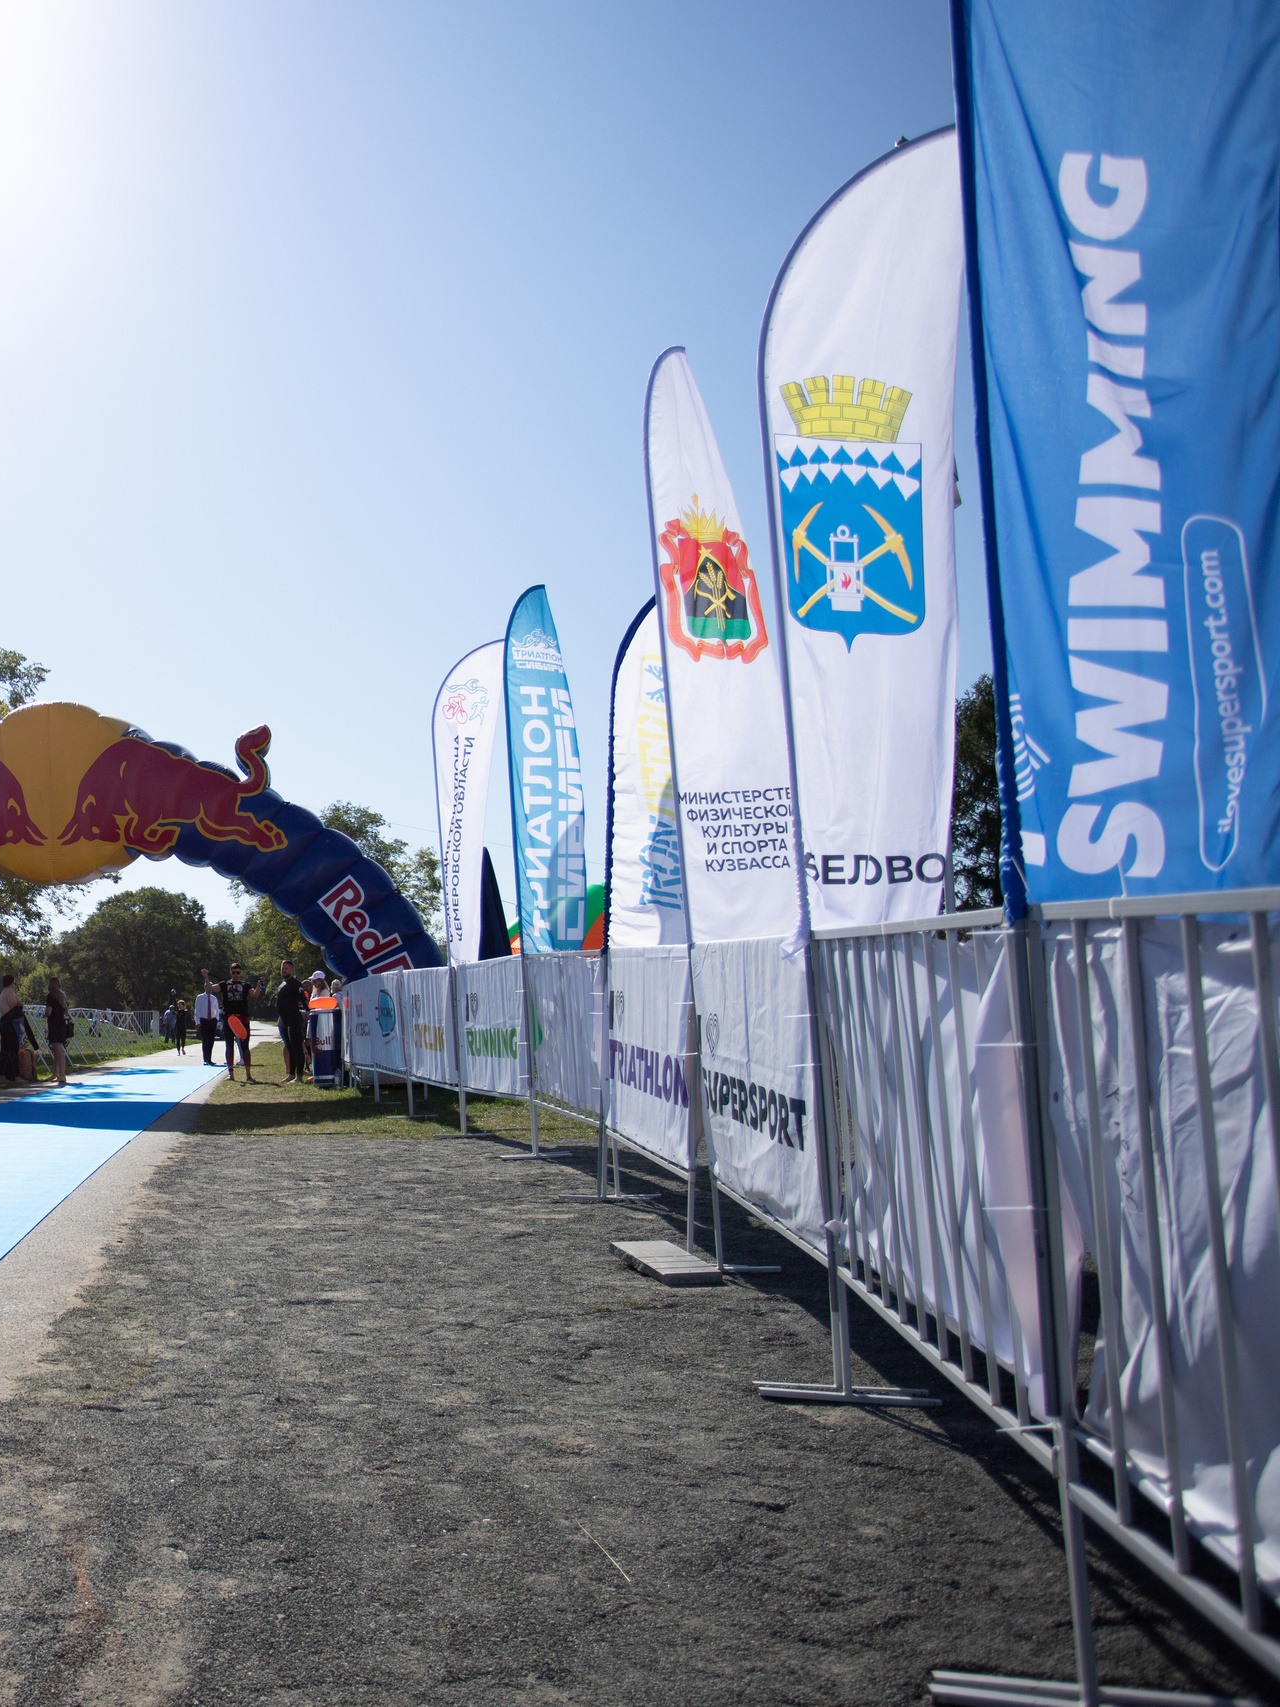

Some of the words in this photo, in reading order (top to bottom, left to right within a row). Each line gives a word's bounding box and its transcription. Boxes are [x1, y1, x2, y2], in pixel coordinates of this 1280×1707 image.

[1056, 152, 1169, 878] SWIMMING
[1199, 549, 1253, 834] ilovesupersport.com
[456, 736, 475, 814] ОБЛАСТИ
[519, 686, 552, 937] ТРИАТЛОН
[701, 821, 788, 838] КУЛЬТУРЫ
[704, 855, 790, 872] КУЗБАССА
[706, 842, 718, 855] И
[721, 838, 788, 855] СПОРТА
[318, 875, 402, 964] Red
[466, 1027, 518, 1059] RUNNING
[609, 1038, 688, 1109] TRIATHLON
